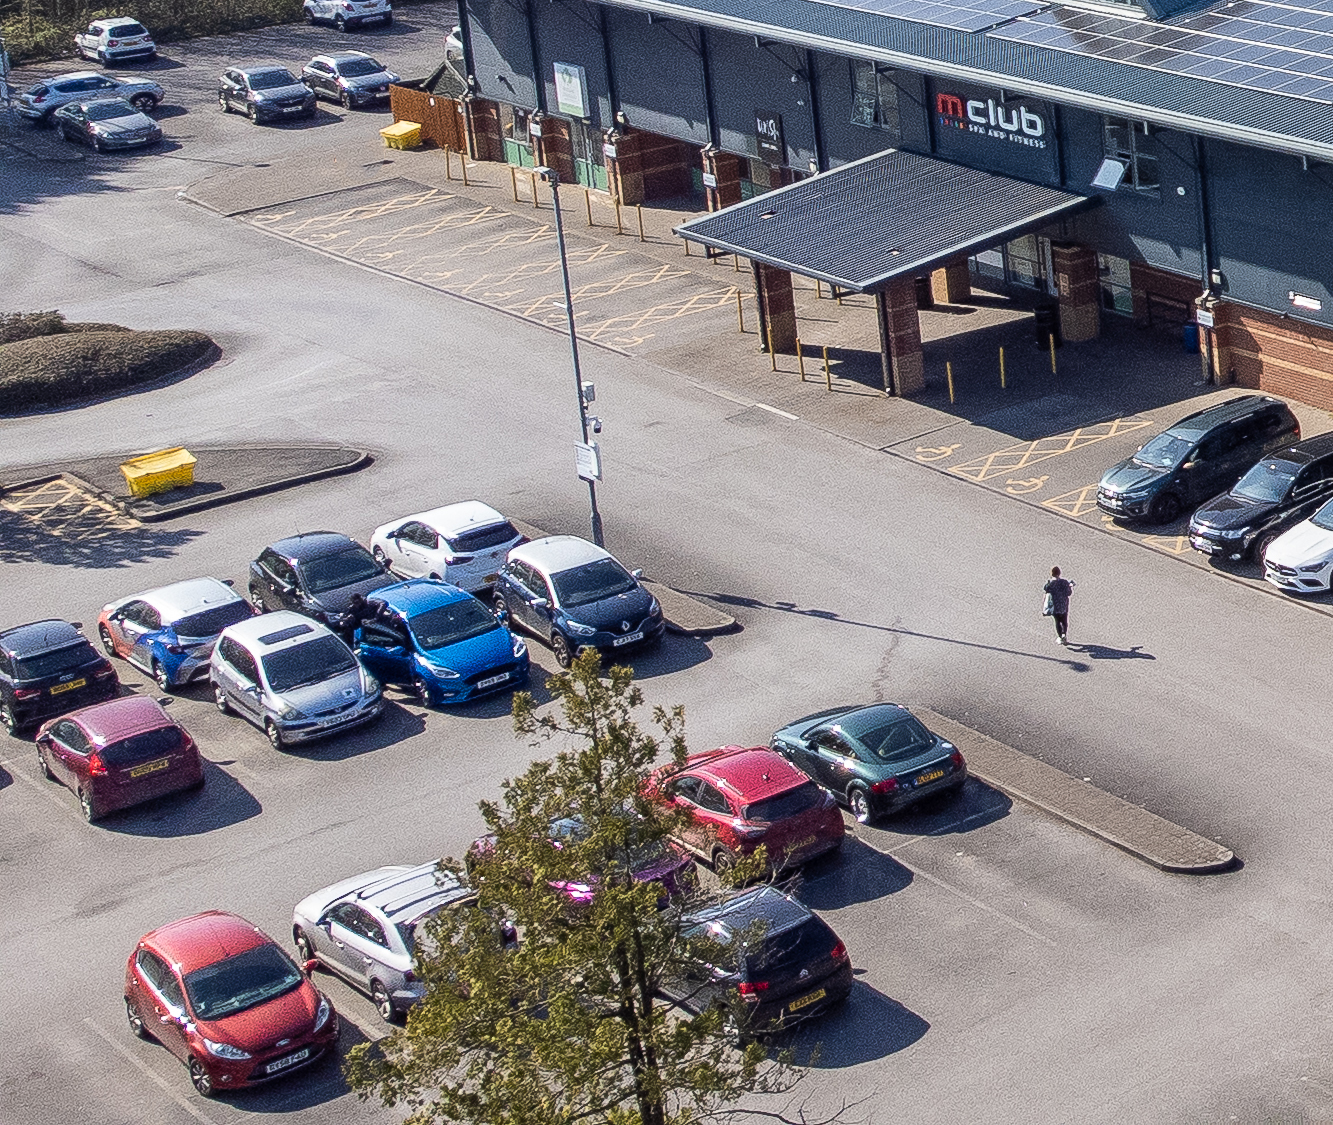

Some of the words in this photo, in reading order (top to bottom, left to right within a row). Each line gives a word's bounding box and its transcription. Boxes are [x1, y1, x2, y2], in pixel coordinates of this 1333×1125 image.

[968, 124, 986, 134] SPA
[987, 129, 1007, 140] AND
[1009, 134, 1047, 149] FITNESS
